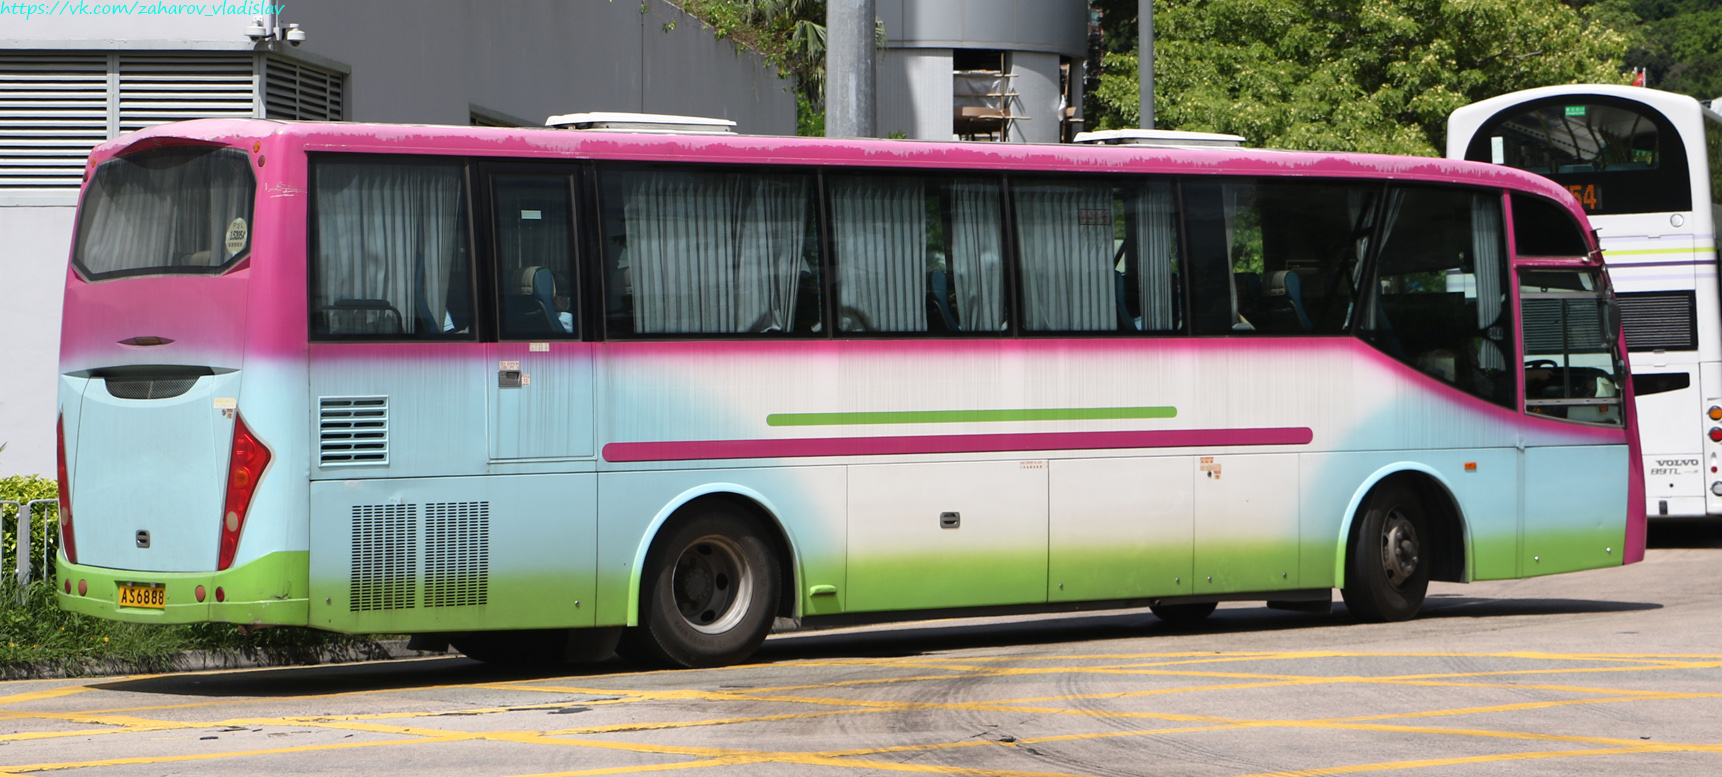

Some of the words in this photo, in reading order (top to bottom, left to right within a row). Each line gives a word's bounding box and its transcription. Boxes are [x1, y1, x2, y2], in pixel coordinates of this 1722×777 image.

[1564, 184, 1597, 209] 54
[1656, 459, 1699, 467] VOLVO
[121, 588, 164, 605] AS6888
